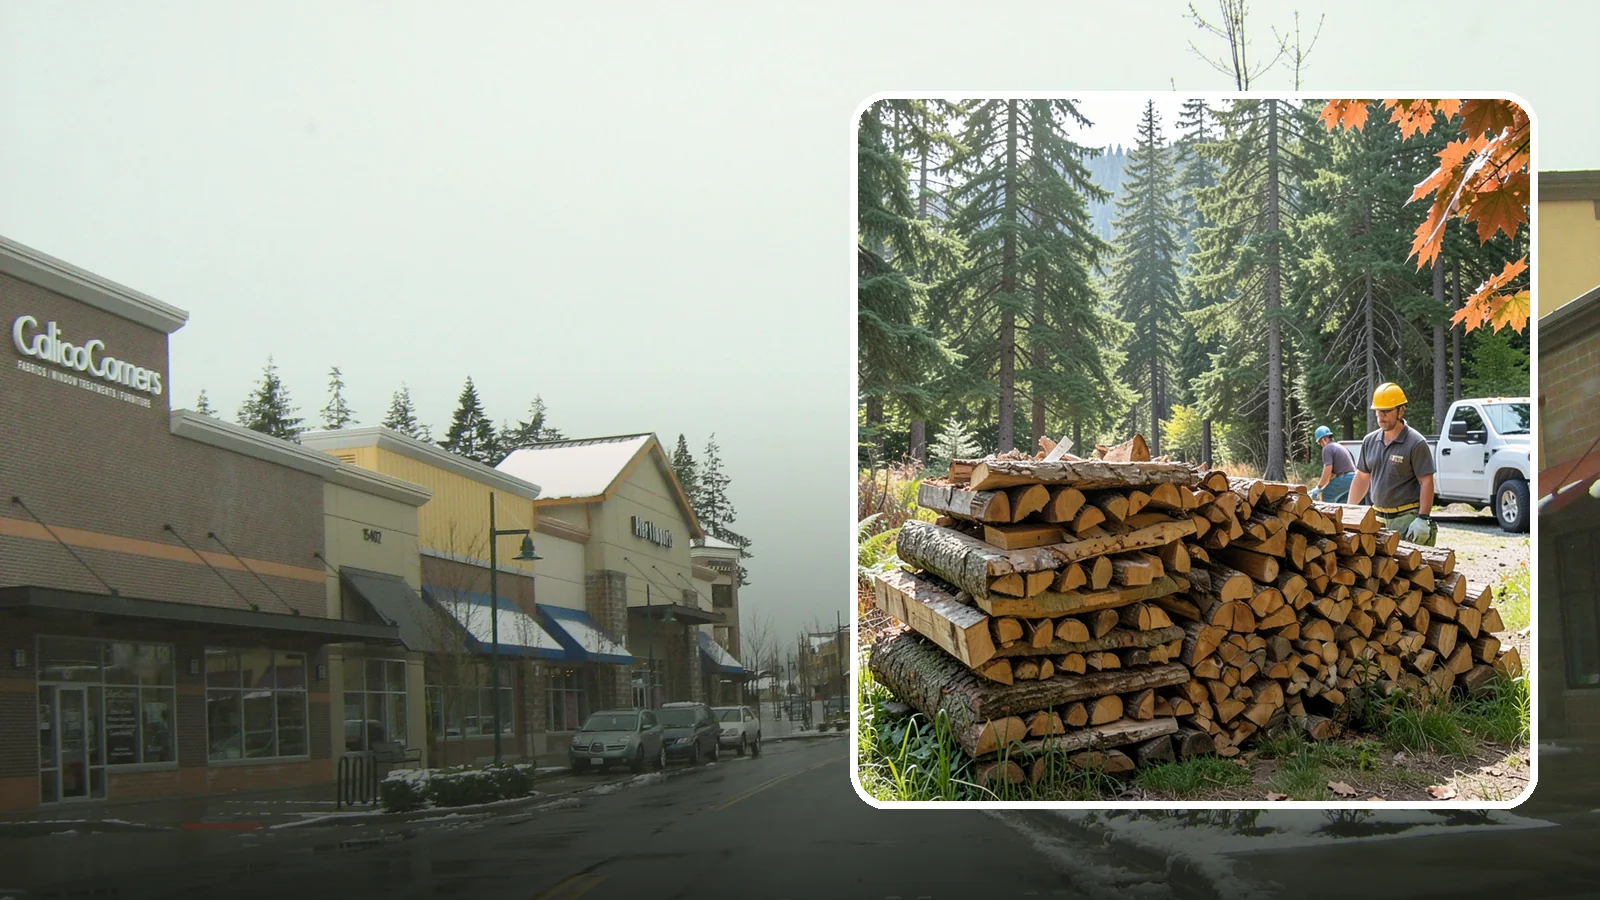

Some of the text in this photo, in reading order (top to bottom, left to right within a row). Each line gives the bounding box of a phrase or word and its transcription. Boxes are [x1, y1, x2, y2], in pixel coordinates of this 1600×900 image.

[17, 360, 47, 377] FABRICS
[51, 370, 77, 386] WINDOW
[79, 379, 117, 398] TREATMENTS
